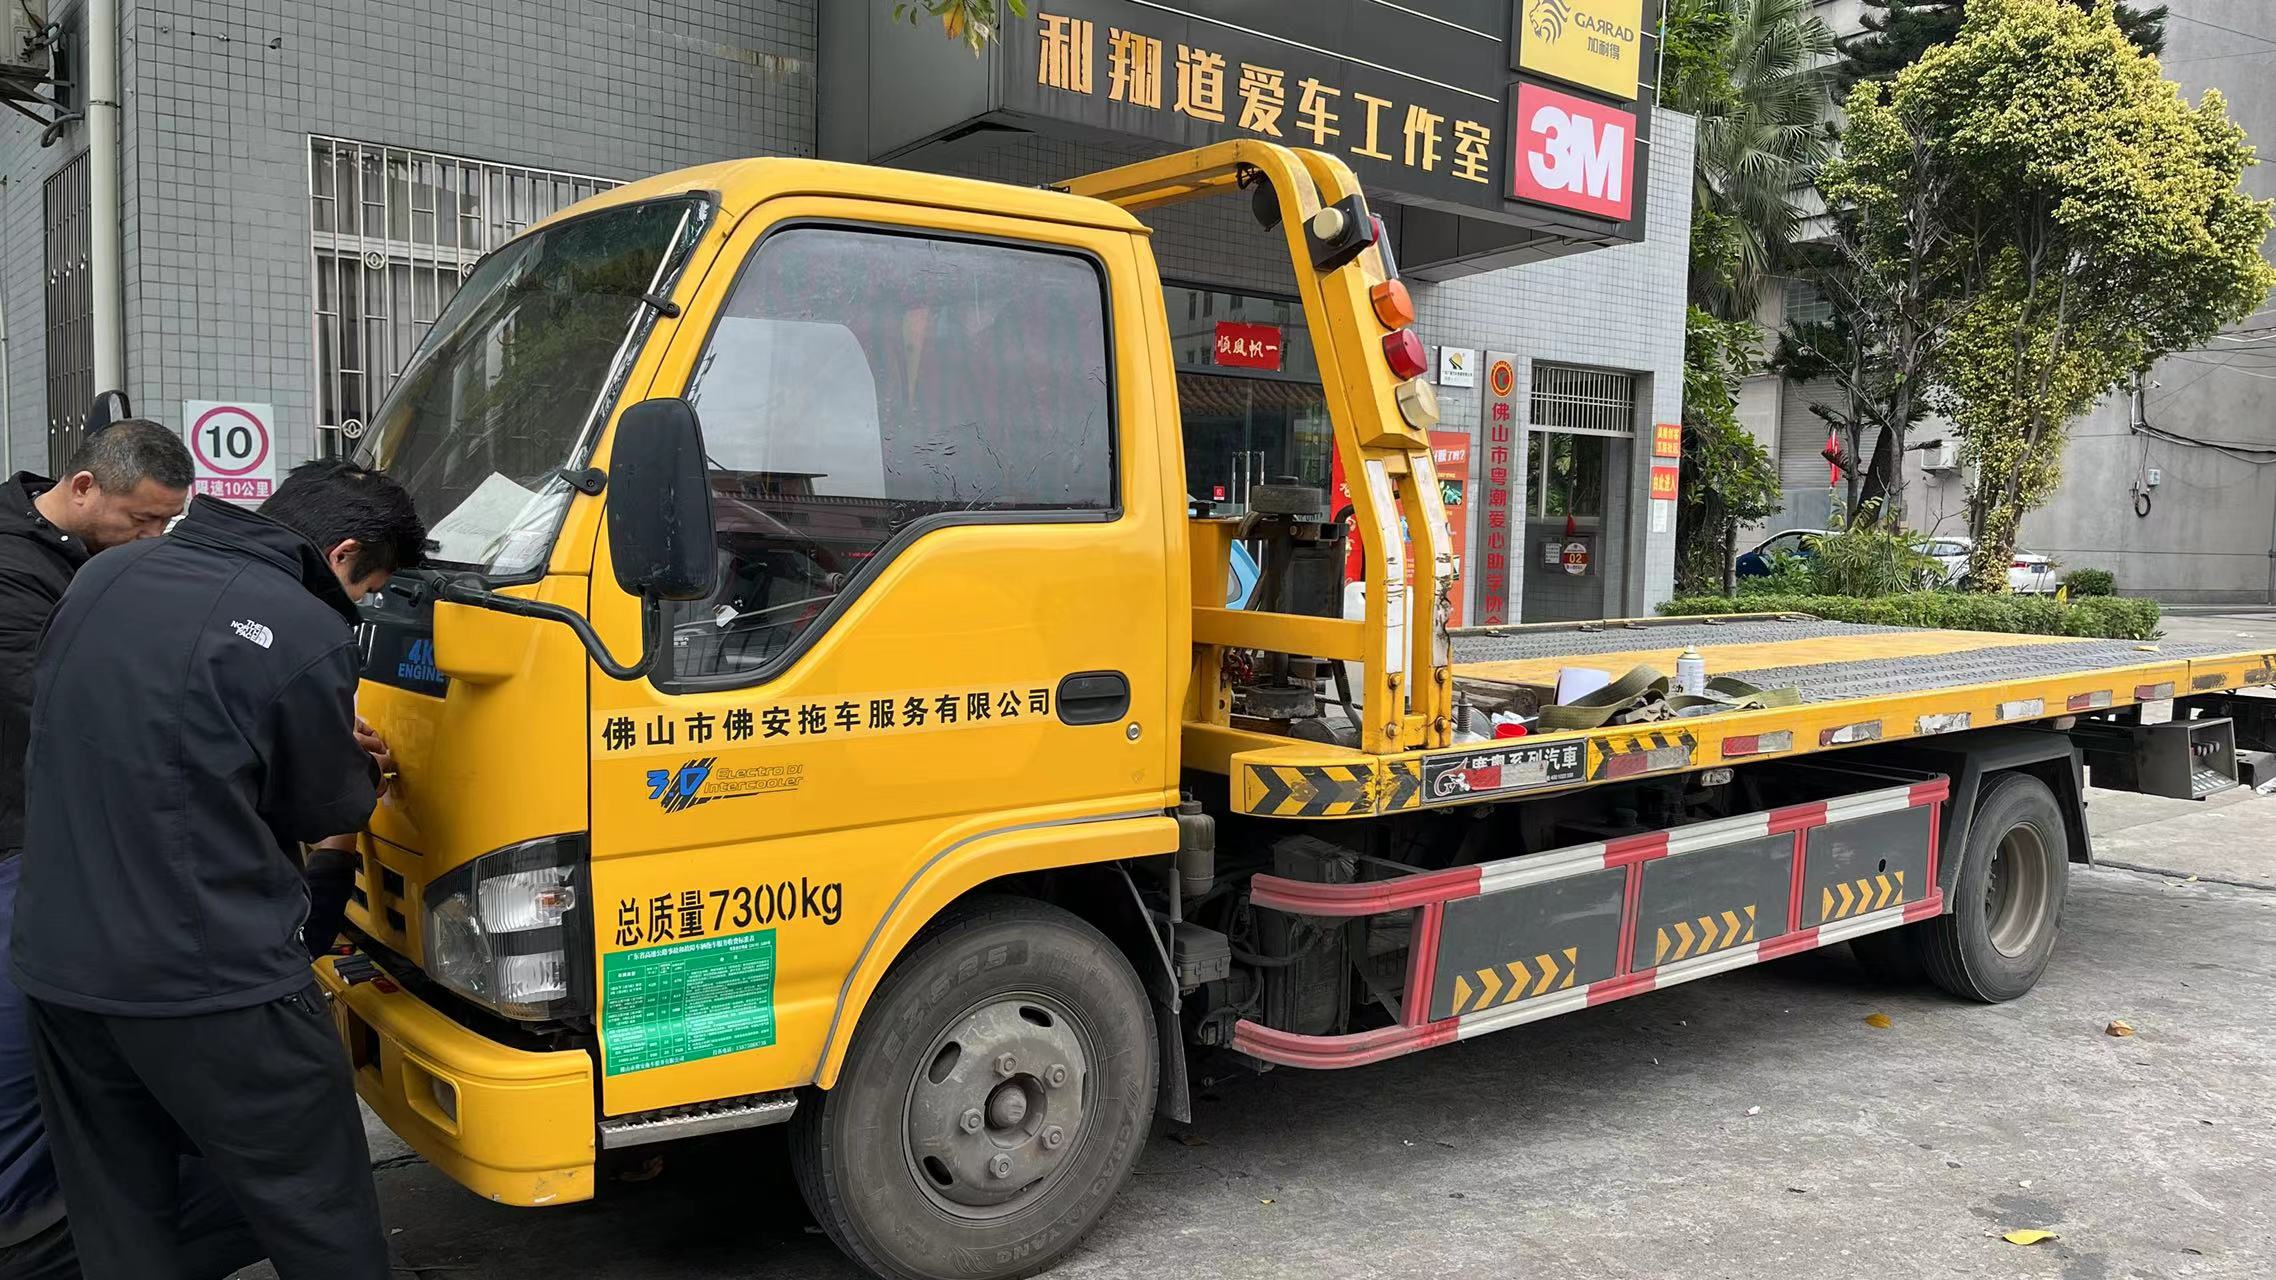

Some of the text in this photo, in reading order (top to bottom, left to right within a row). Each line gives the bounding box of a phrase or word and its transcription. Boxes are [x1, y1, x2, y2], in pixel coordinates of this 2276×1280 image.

[1587, 36, 1620, 60] 加耐得
[1037, 11, 1490, 185] 利翔道爱车工作室
[1529, 105, 1624, 202] 3M
[206, 426, 253, 458] 10
[195, 480, 269, 496] 限速10公里
[1569, 553, 1582, 564] 02
[230, 620, 261, 637] NORTH
[235, 628, 257, 641] FACE
[247, 619, 263, 632] THE
[398, 663, 445, 683] ENGINE
[602, 688, 1052, 752] 佛山市佛安拖车服务有限公司
